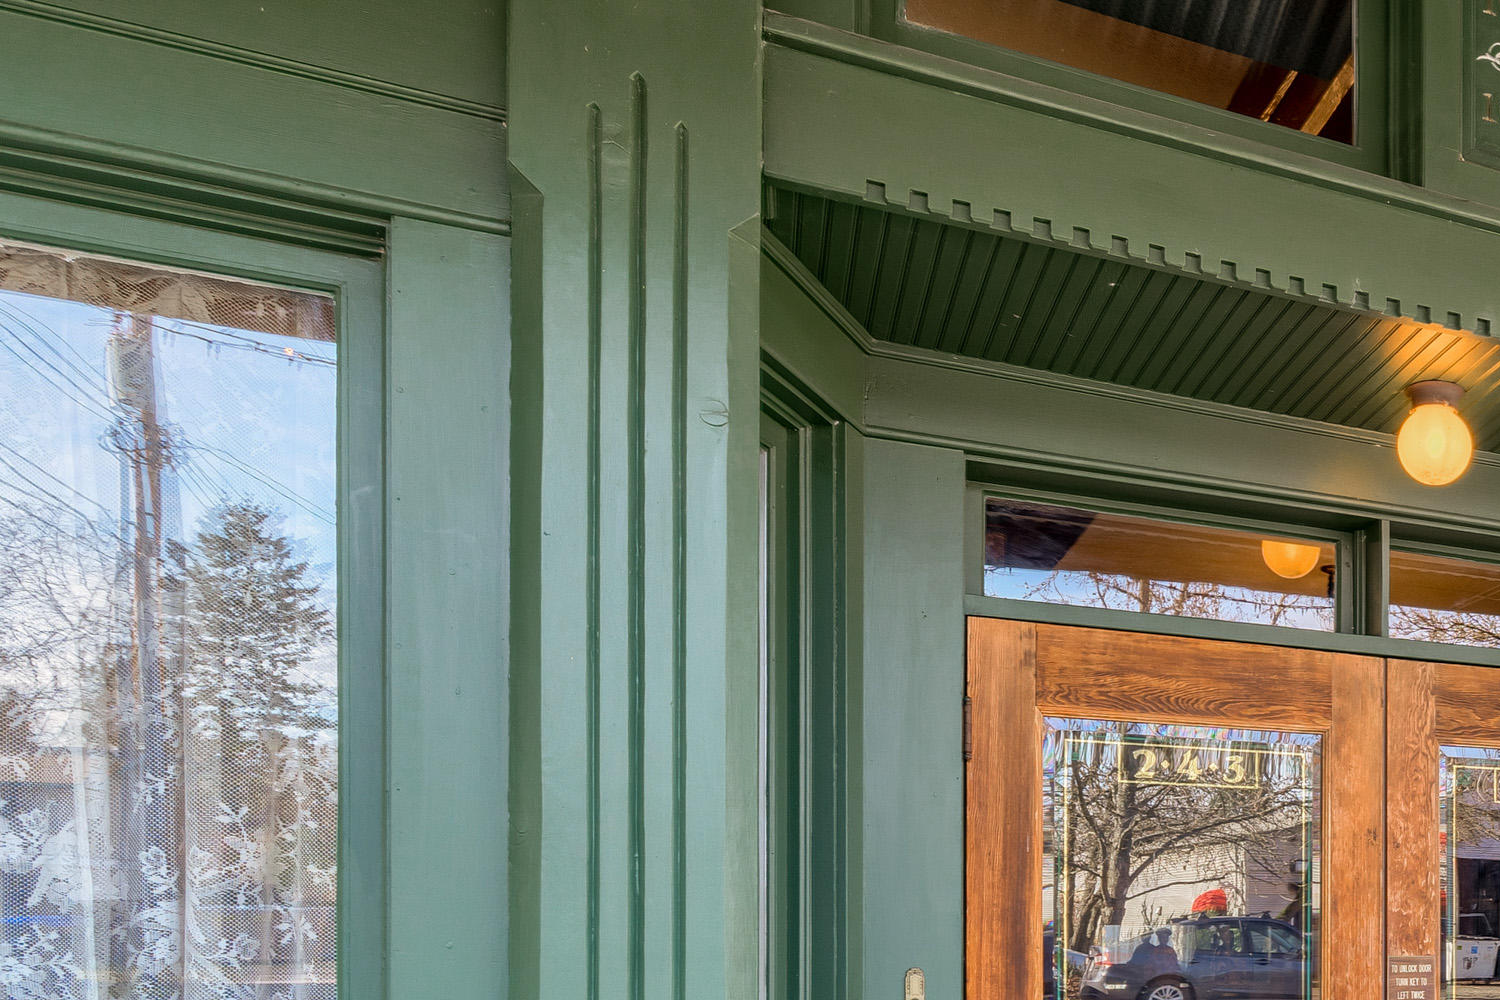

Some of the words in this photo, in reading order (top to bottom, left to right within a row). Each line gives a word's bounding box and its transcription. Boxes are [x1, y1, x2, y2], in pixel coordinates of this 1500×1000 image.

[1392, 965, 1398, 973] TO
[1400, 964, 1417, 972] UNLOCK
[1419, 964, 1432, 972] DOOR
[1396, 978, 1408, 986] TURN
[1410, 978, 1419, 986] KEY
[1397, 991, 1408, 999] LEFT
[1411, 991, 1425, 999] TWICE
